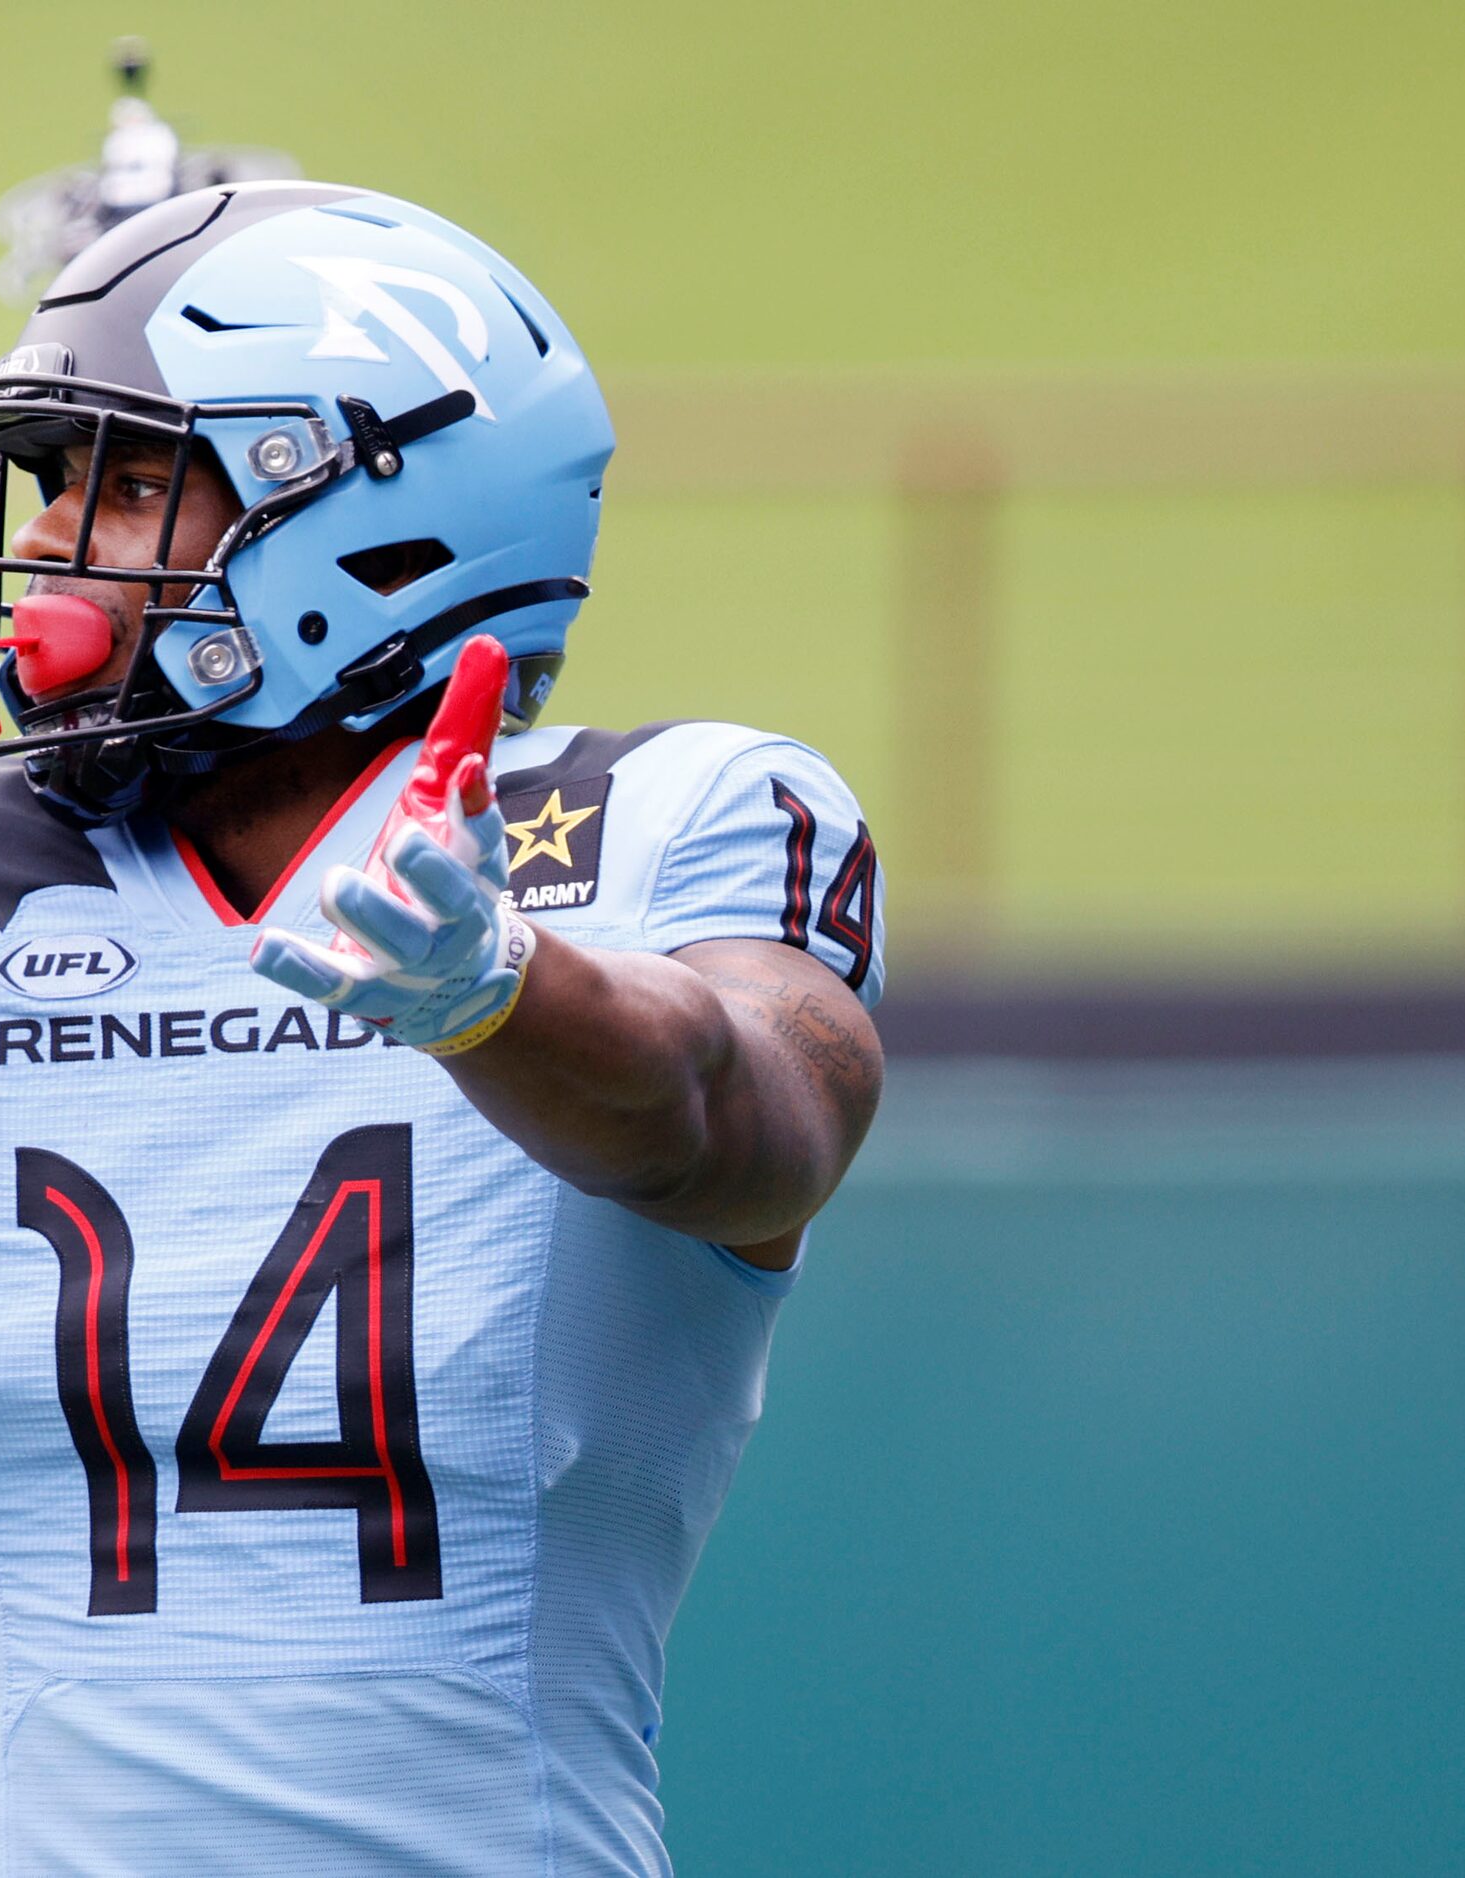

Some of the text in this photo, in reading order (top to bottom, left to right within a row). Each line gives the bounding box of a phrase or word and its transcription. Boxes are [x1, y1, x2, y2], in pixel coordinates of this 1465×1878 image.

[520, 880, 595, 908] ARMY
[770, 777, 876, 992] 14
[23, 952, 112, 977] UFL
[15, 1122, 444, 1616] 14
